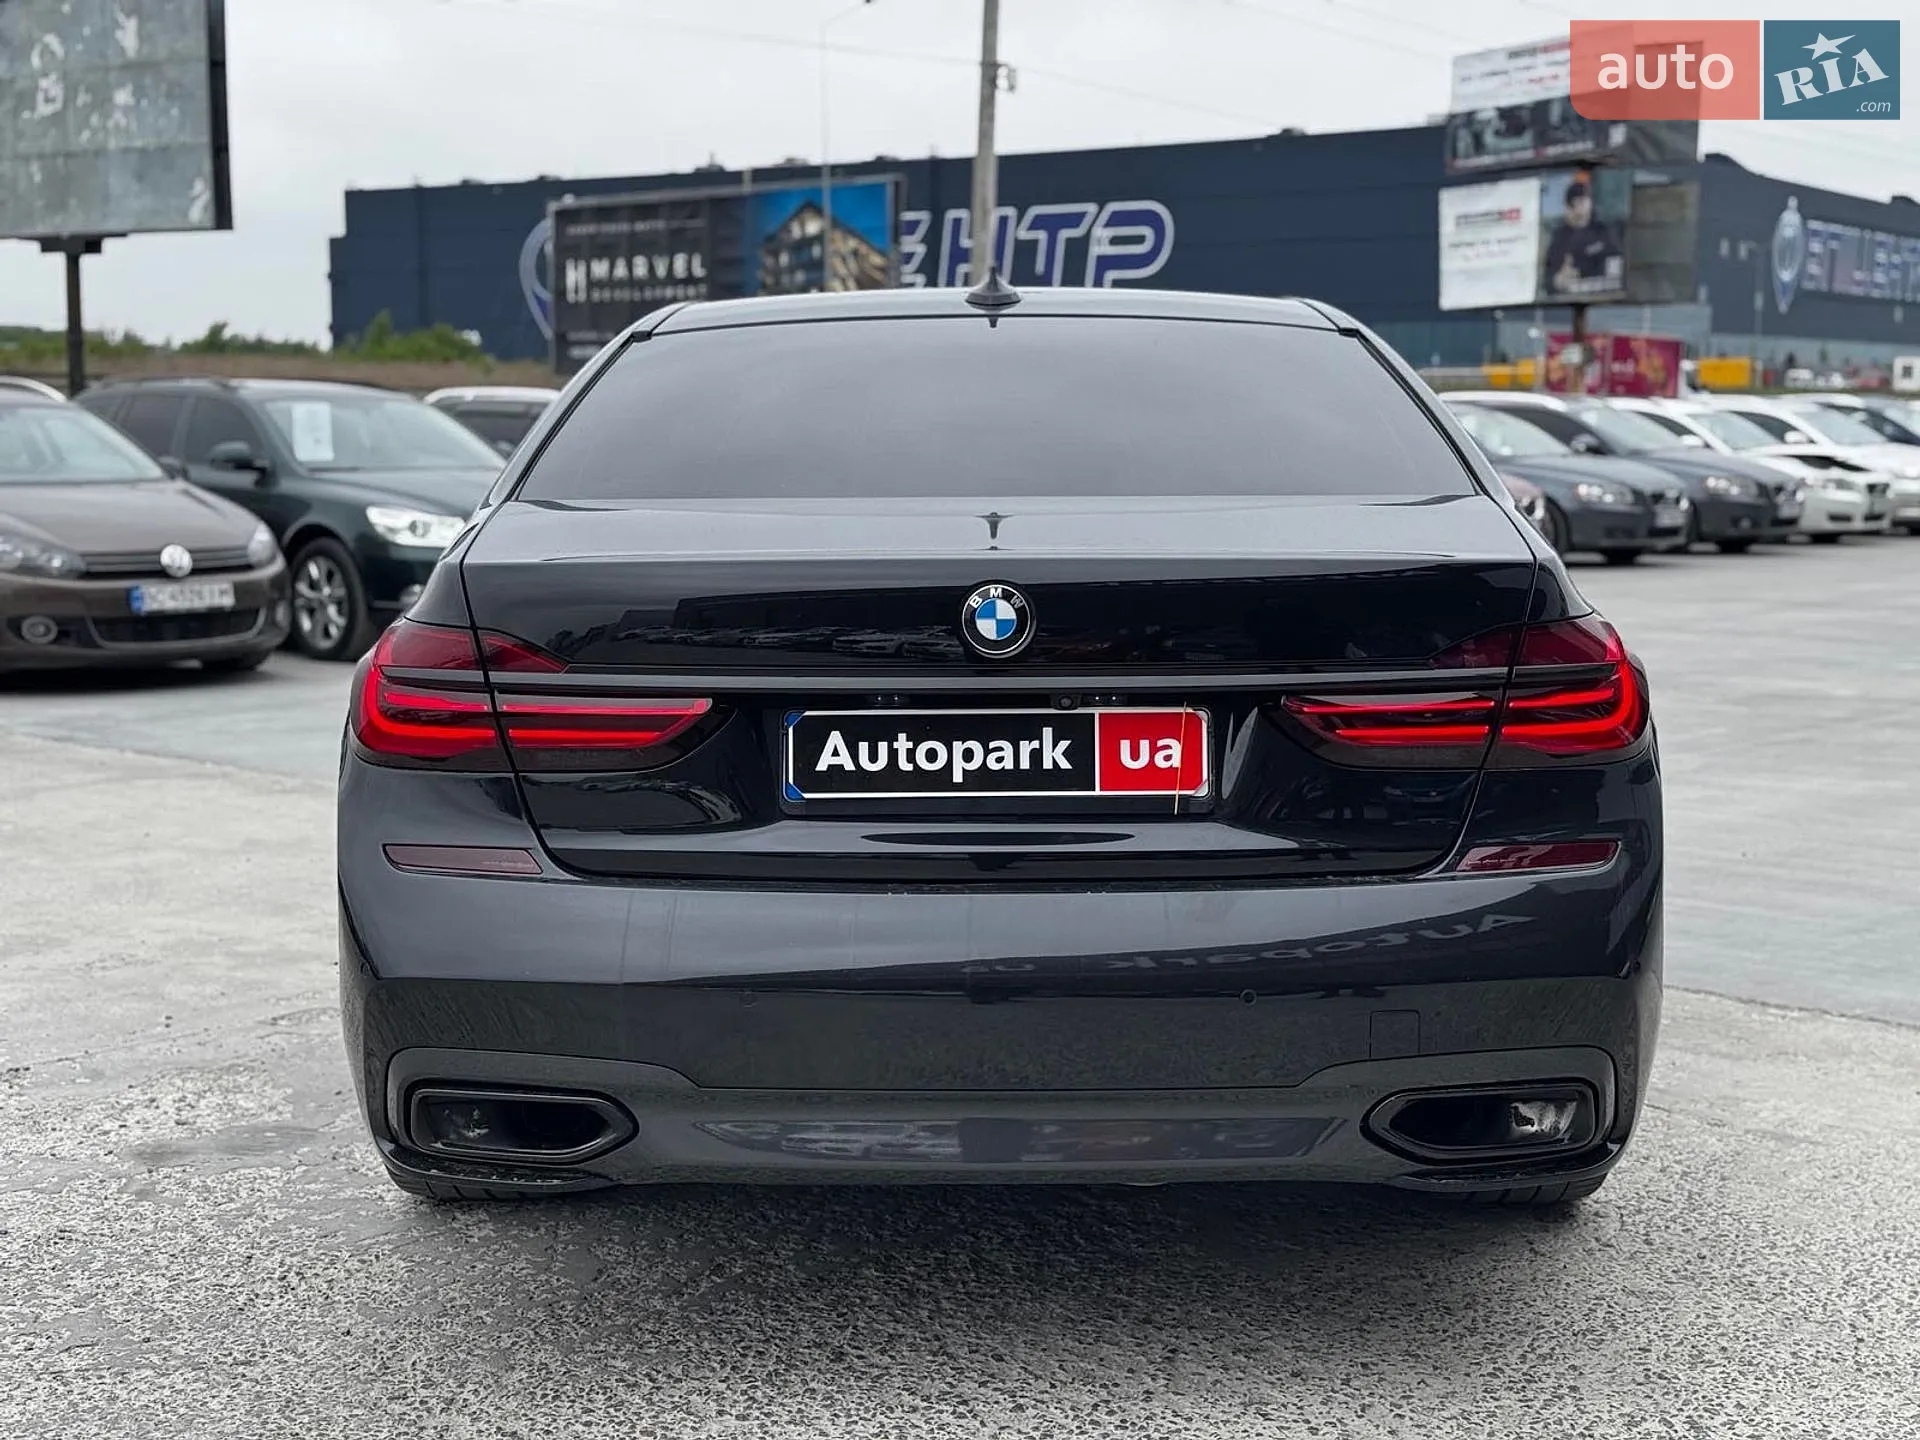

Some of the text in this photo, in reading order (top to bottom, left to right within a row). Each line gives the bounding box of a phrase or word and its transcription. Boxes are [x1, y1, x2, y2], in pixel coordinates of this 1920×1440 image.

[590, 252, 707, 281] MARVEL
[814, 726, 1182, 783] Autopark ua
